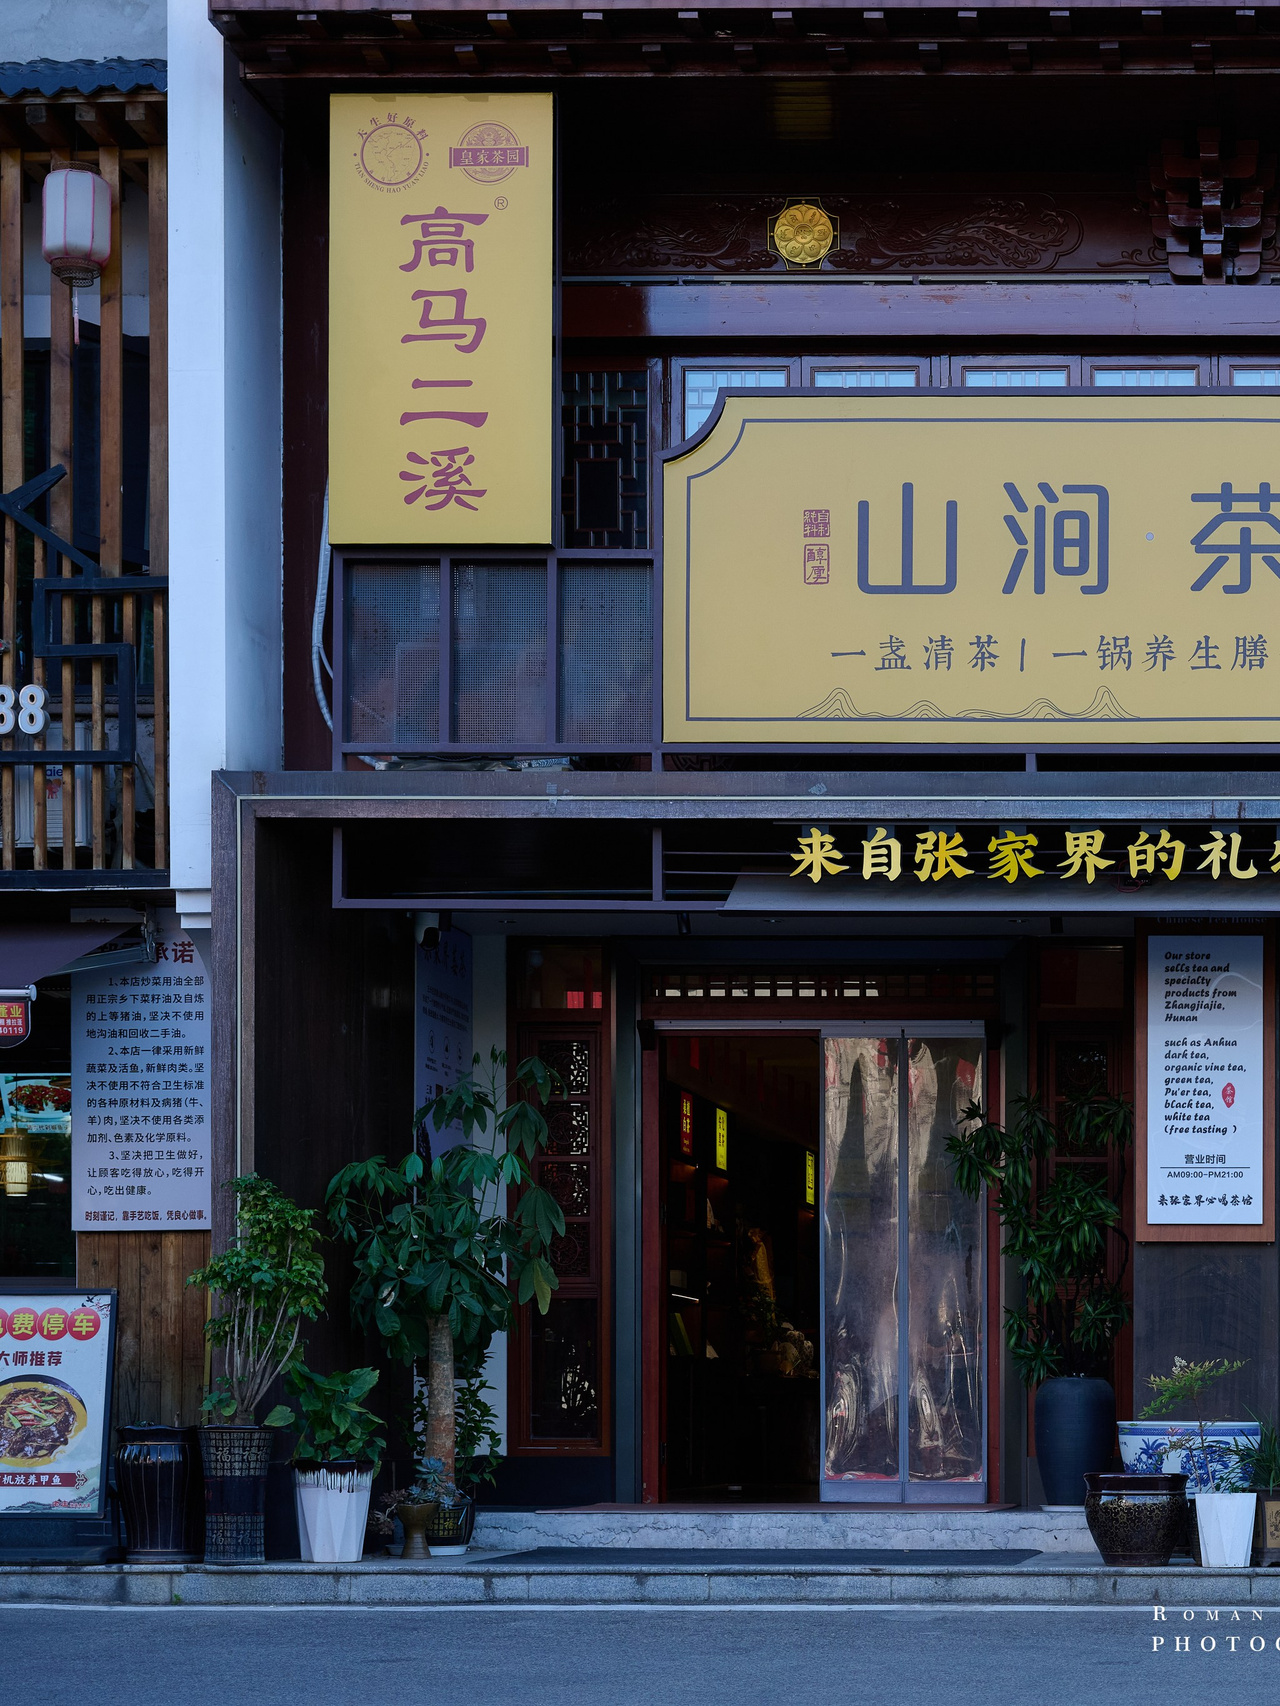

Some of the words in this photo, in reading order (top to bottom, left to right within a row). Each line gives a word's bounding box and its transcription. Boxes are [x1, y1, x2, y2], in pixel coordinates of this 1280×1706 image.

[358, 112, 429, 141] 天生好原料
[460, 150, 519, 165] 皇家茶园
[354, 162, 364, 179] TIAN
[364, 178, 385, 193] SHENG
[387, 186, 401, 194] HAO
[402, 176, 420, 191] YUAN
[418, 161, 429, 177] LIAO
[399, 205, 490, 512] 高马二溪
[45, 766, 63, 777] aie
[1165, 951, 1183, 960] Our
[1185, 951, 1211, 960] store
[1165, 963, 1190, 973] sells
[1192, 964, 1209, 973] tea
[1211, 963, 1230, 973] and
[109, 976, 204, 987] 1、本店炒菜用油全部
[1165, 976, 1211, 987] specialty
[1165, 988, 1210, 999] products
[1212, 989, 1237, 999] from
[86, 994, 205, 1005] 用正宗乡下菜籽油及自炼
[1165, 1000, 1225, 1012] Zhangjiajie,
[1165, 1014, 1198, 1022] Hunan
[1165, 1037, 1188, 1047] such
[1204, 1037, 1238, 1047] Anhua
[108, 1046, 205, 1057] 2、本店一律采用新鲜
[1165, 1050, 1188, 1060] dark
[1190, 1052, 1209, 1060] tea,
[1165, 1063, 1202, 1073] organic
[1205, 1063, 1225, 1072] vine
[1227, 1063, 1247, 1073] tea,
[86, 1080, 205, 1091] 决不使用不符合卫生标准
[1164, 1076, 1193, 1086] green
[1195, 1076, 1214, 1085] tea,
[1164, 1088, 1190, 1097] Pu'er
[1192, 1088, 1212, 1097] tea,
[1164, 1099, 1193, 1109] black
[1196, 1100, 1215, 1110] tea,
[1164, 1112, 1192, 1121] white
[1194, 1113, 1210, 1121] tea
[1164, 1125, 1190, 1135] (free
[1185, 1154, 1226, 1165] 营业时间
[1167, 1171, 1244, 1179] AM09:00-PM21:00
[0, 1313, 95, 1336] 费停车
[0, 1475, 62, 1486] 机放养甲鱼
